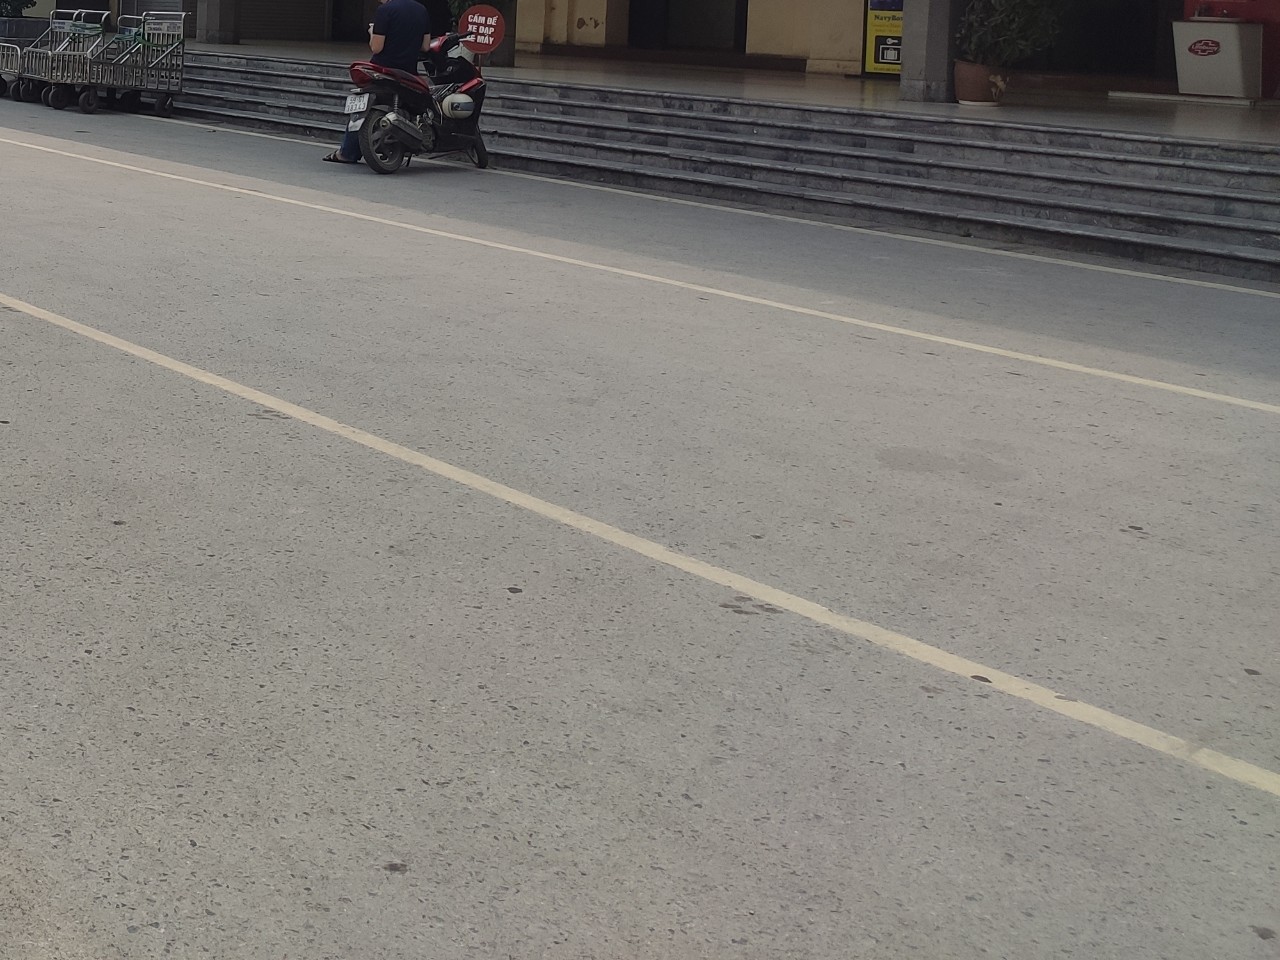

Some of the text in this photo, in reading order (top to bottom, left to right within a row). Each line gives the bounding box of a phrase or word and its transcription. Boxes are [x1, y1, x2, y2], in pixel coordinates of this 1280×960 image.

[467, 13, 485, 24] CẤM
[467, 24, 495, 36] XE ĐẠP
[477, 35, 495, 45] MÁY
